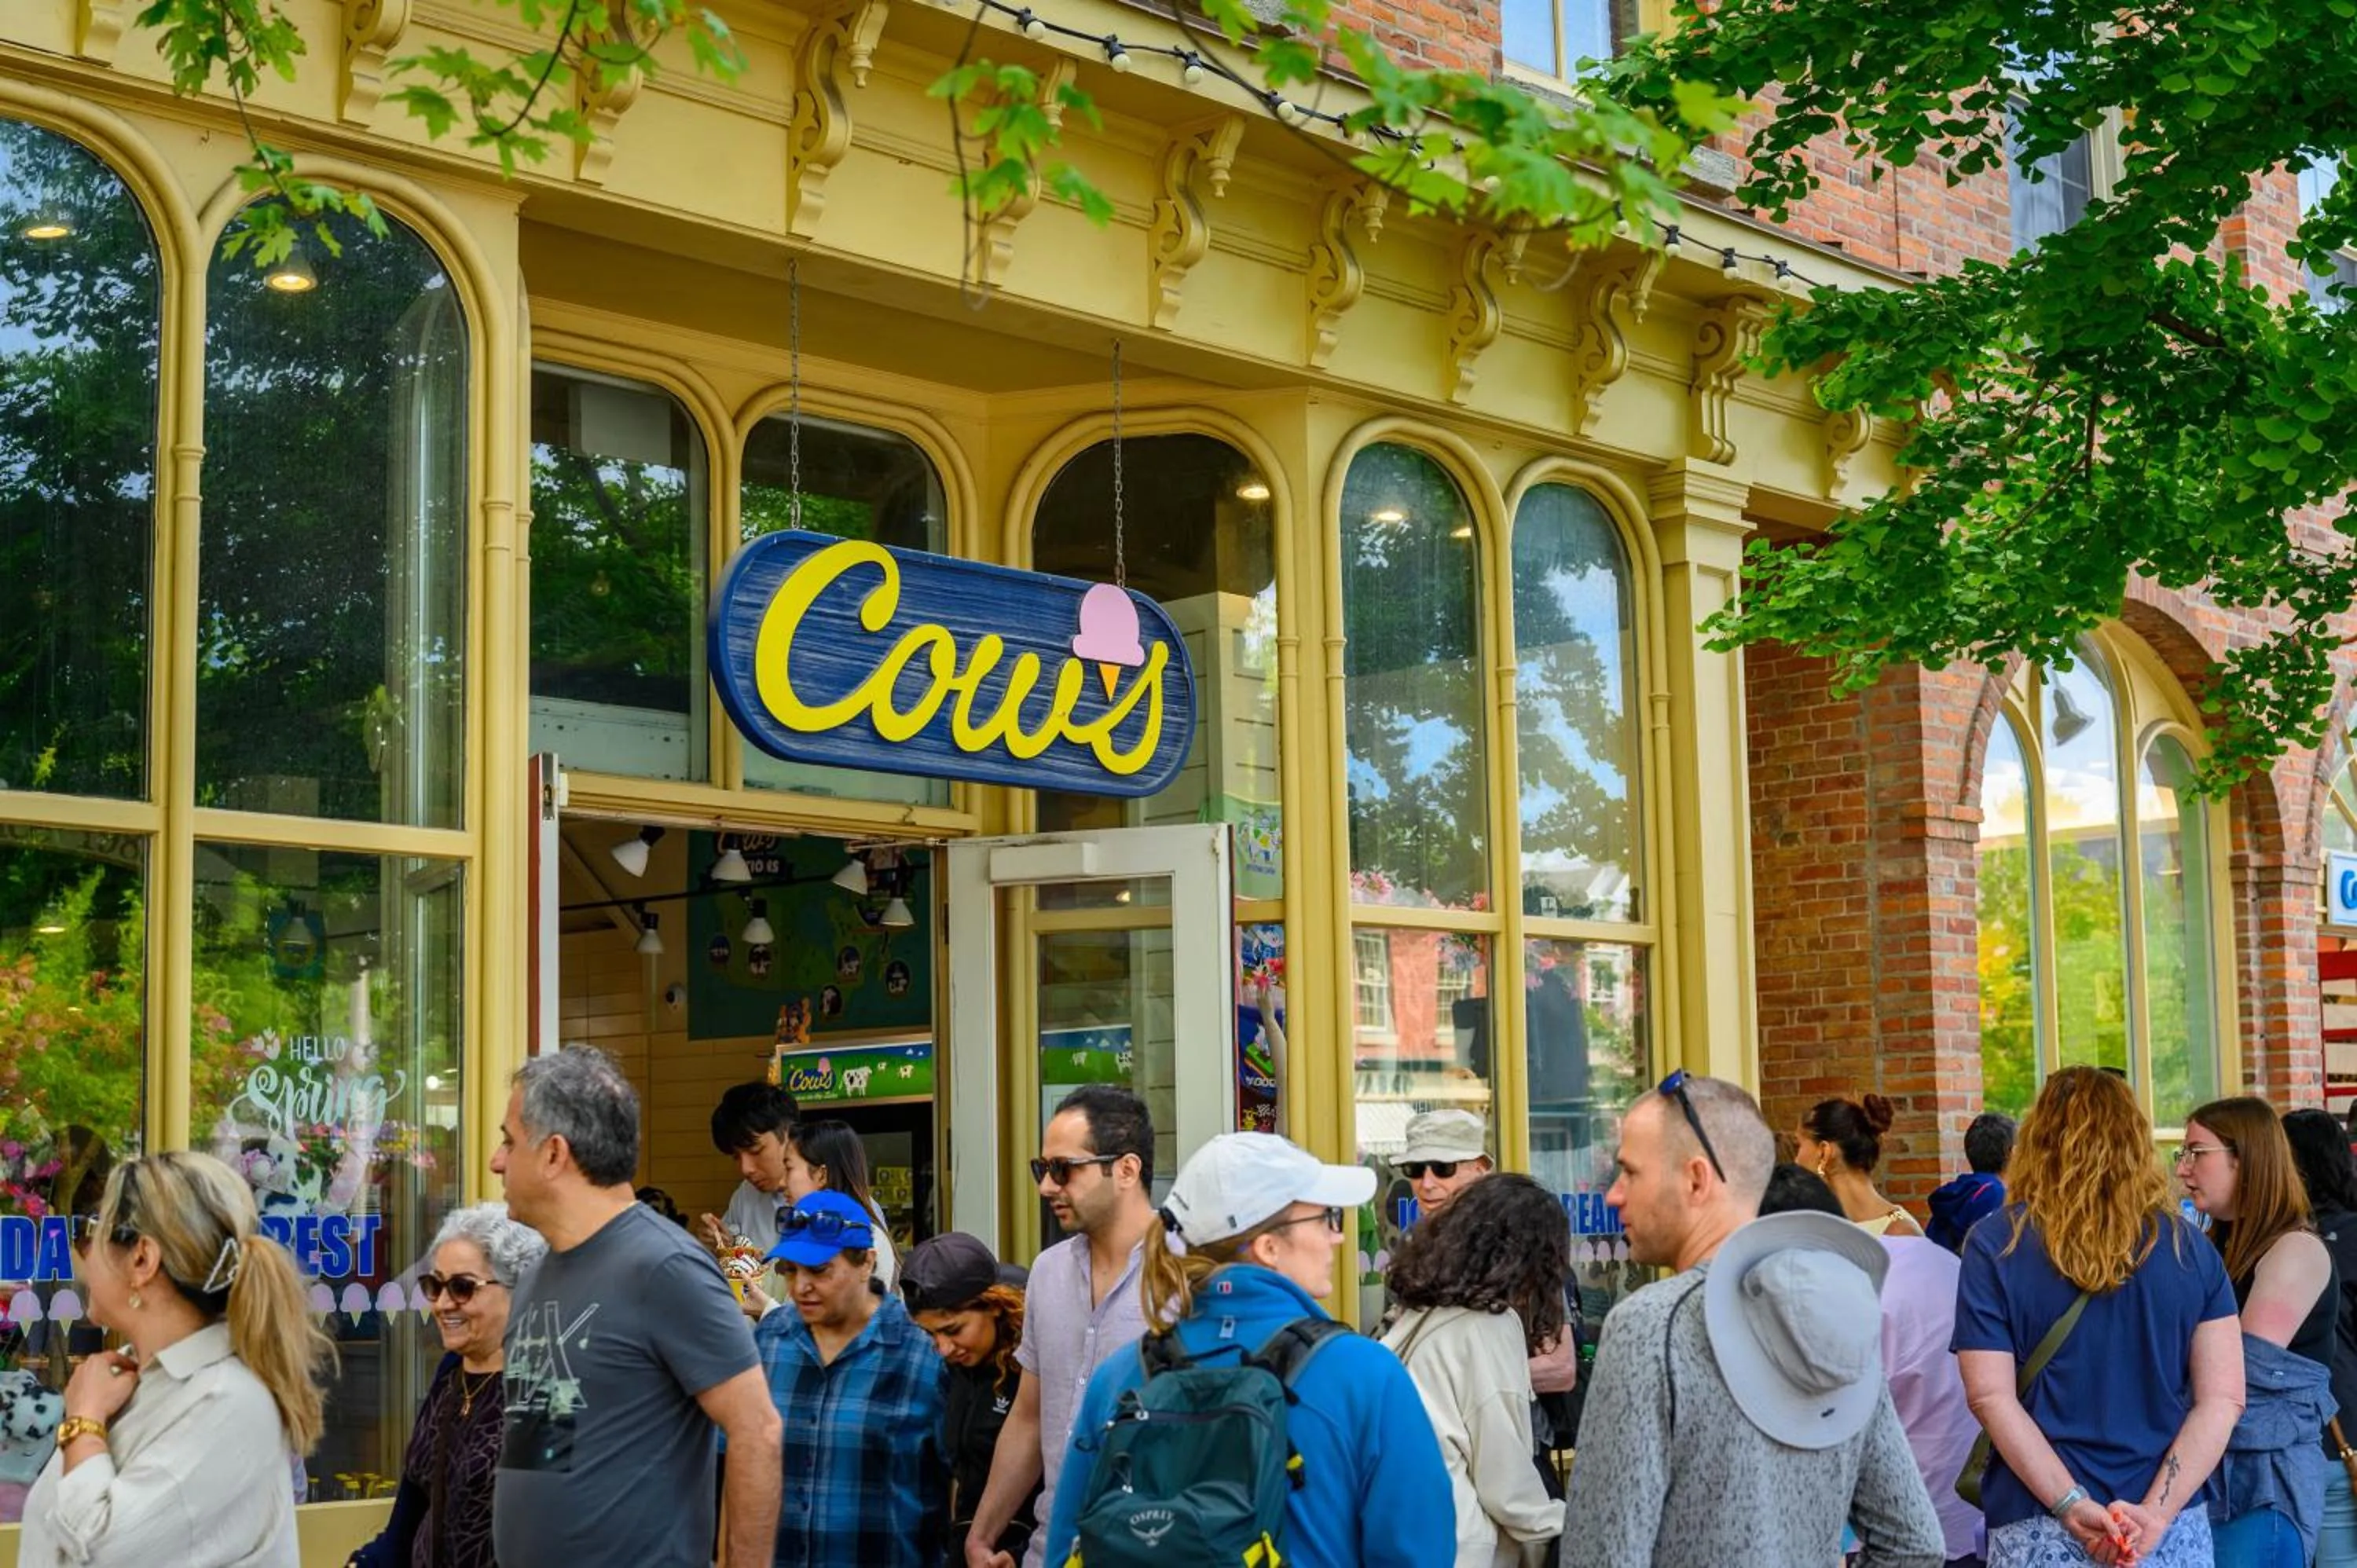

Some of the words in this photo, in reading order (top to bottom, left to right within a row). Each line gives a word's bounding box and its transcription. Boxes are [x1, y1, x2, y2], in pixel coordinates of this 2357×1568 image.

[755, 540, 1170, 775] Cows
[288, 1036, 346, 1061] HELLO
[226, 1064, 406, 1143] Spring
[790, 1068, 833, 1091] Cows
